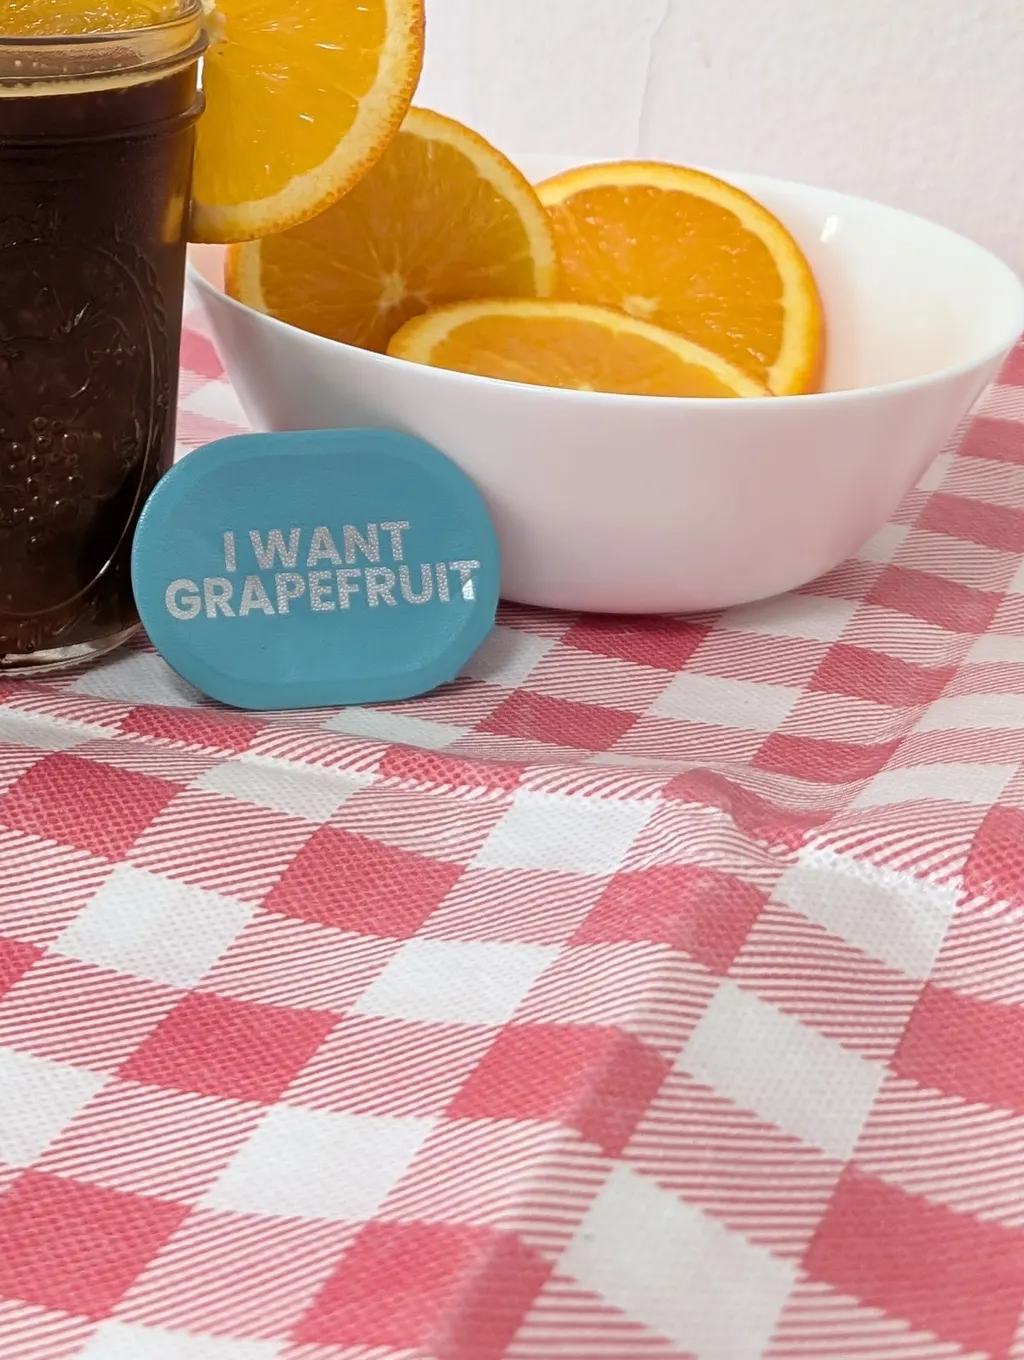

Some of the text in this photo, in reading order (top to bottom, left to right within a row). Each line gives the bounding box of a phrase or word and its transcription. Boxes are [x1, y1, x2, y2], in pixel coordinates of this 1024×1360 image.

[223, 521, 410, 572] I WANT
[165, 560, 480, 620] GRAPEFRUIT
